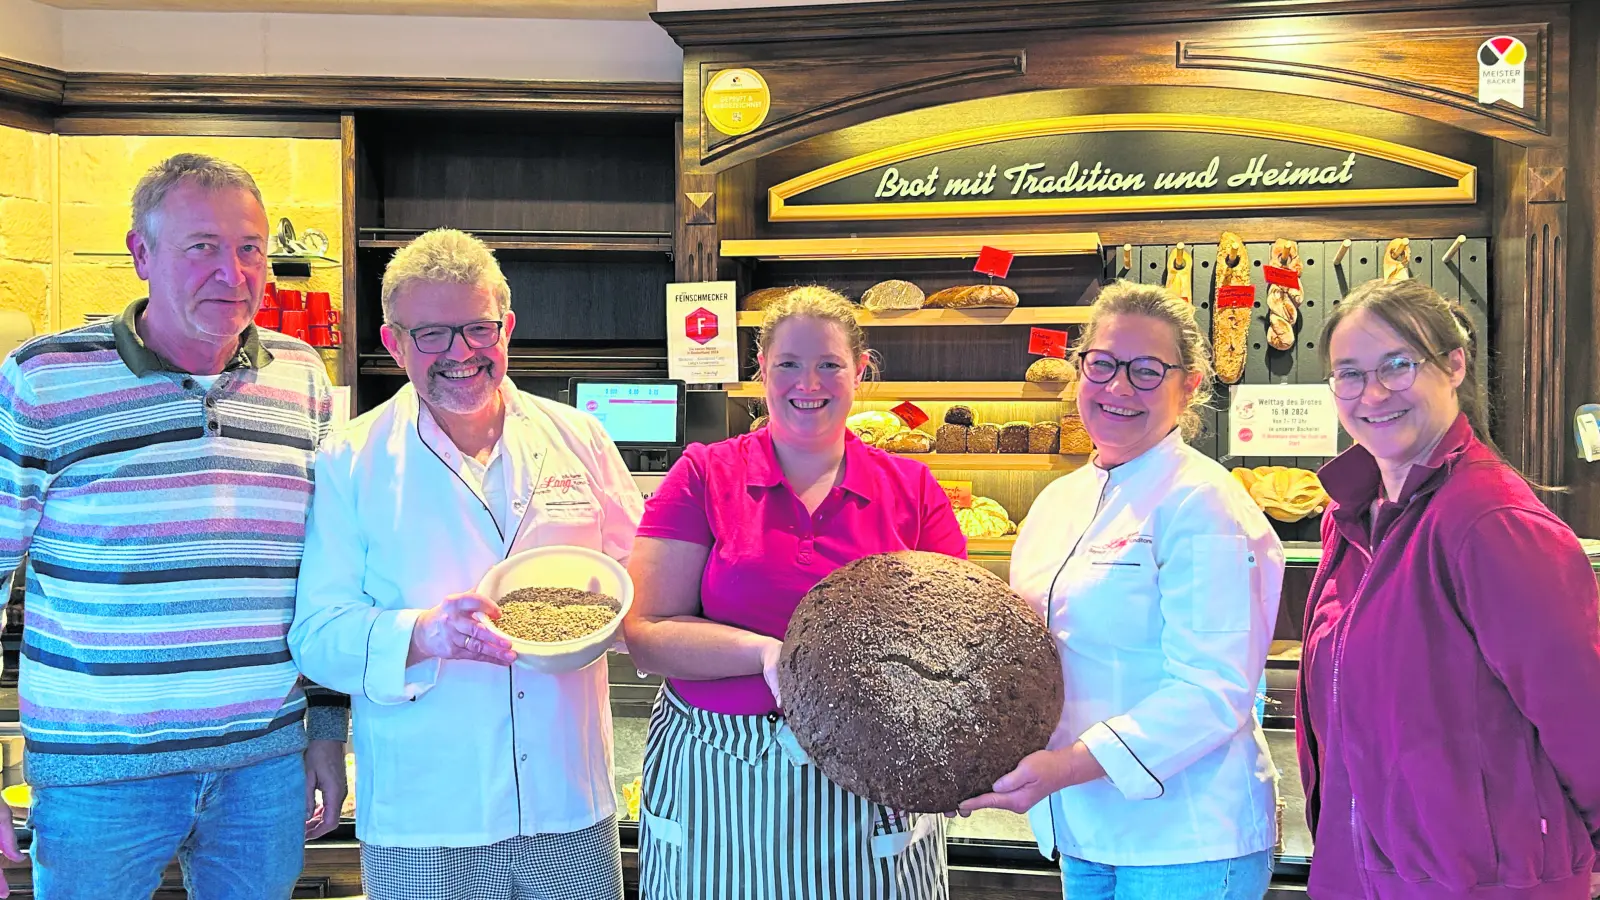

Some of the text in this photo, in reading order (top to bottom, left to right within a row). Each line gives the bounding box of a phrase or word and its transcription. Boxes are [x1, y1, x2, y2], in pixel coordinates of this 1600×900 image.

[1482, 70, 1520, 78] MEISTER
[875, 153, 1355, 197] Brot mit Tradition und Heimat
[675, 293, 728, 303] FEINSCHMECKER
[697, 318, 706, 335] F
[1258, 398, 1284, 407] Welttag
[541, 476, 571, 494] Lang
